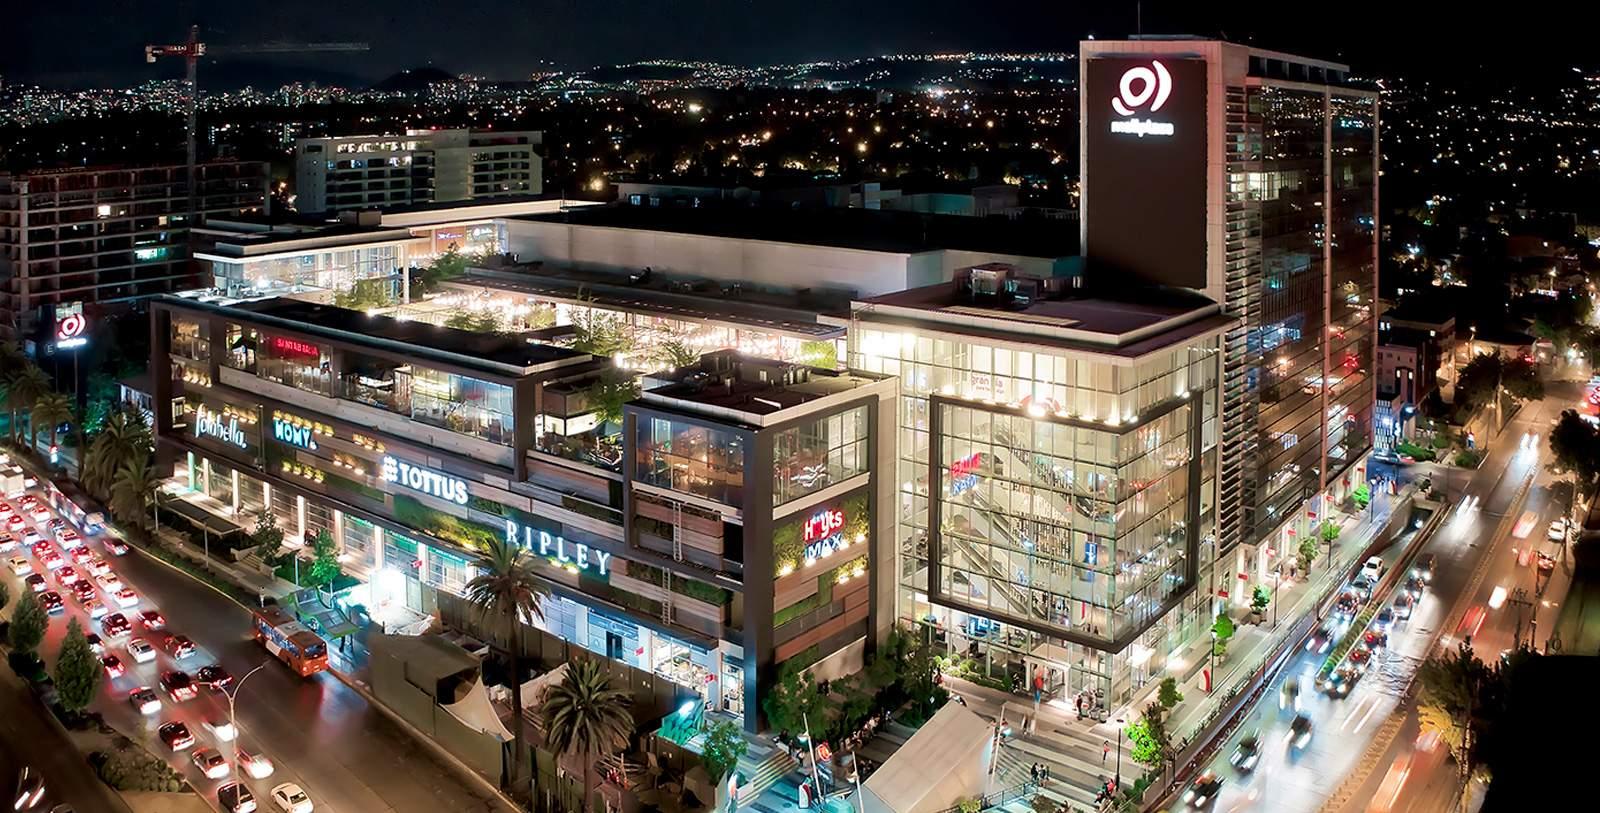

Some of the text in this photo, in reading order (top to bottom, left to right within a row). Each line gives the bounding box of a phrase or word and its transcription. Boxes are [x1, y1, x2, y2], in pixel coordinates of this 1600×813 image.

[398, 462, 469, 505] TOTTUS
[505, 519, 611, 576] RIPLEY
[804, 533, 842, 561] IMAX
